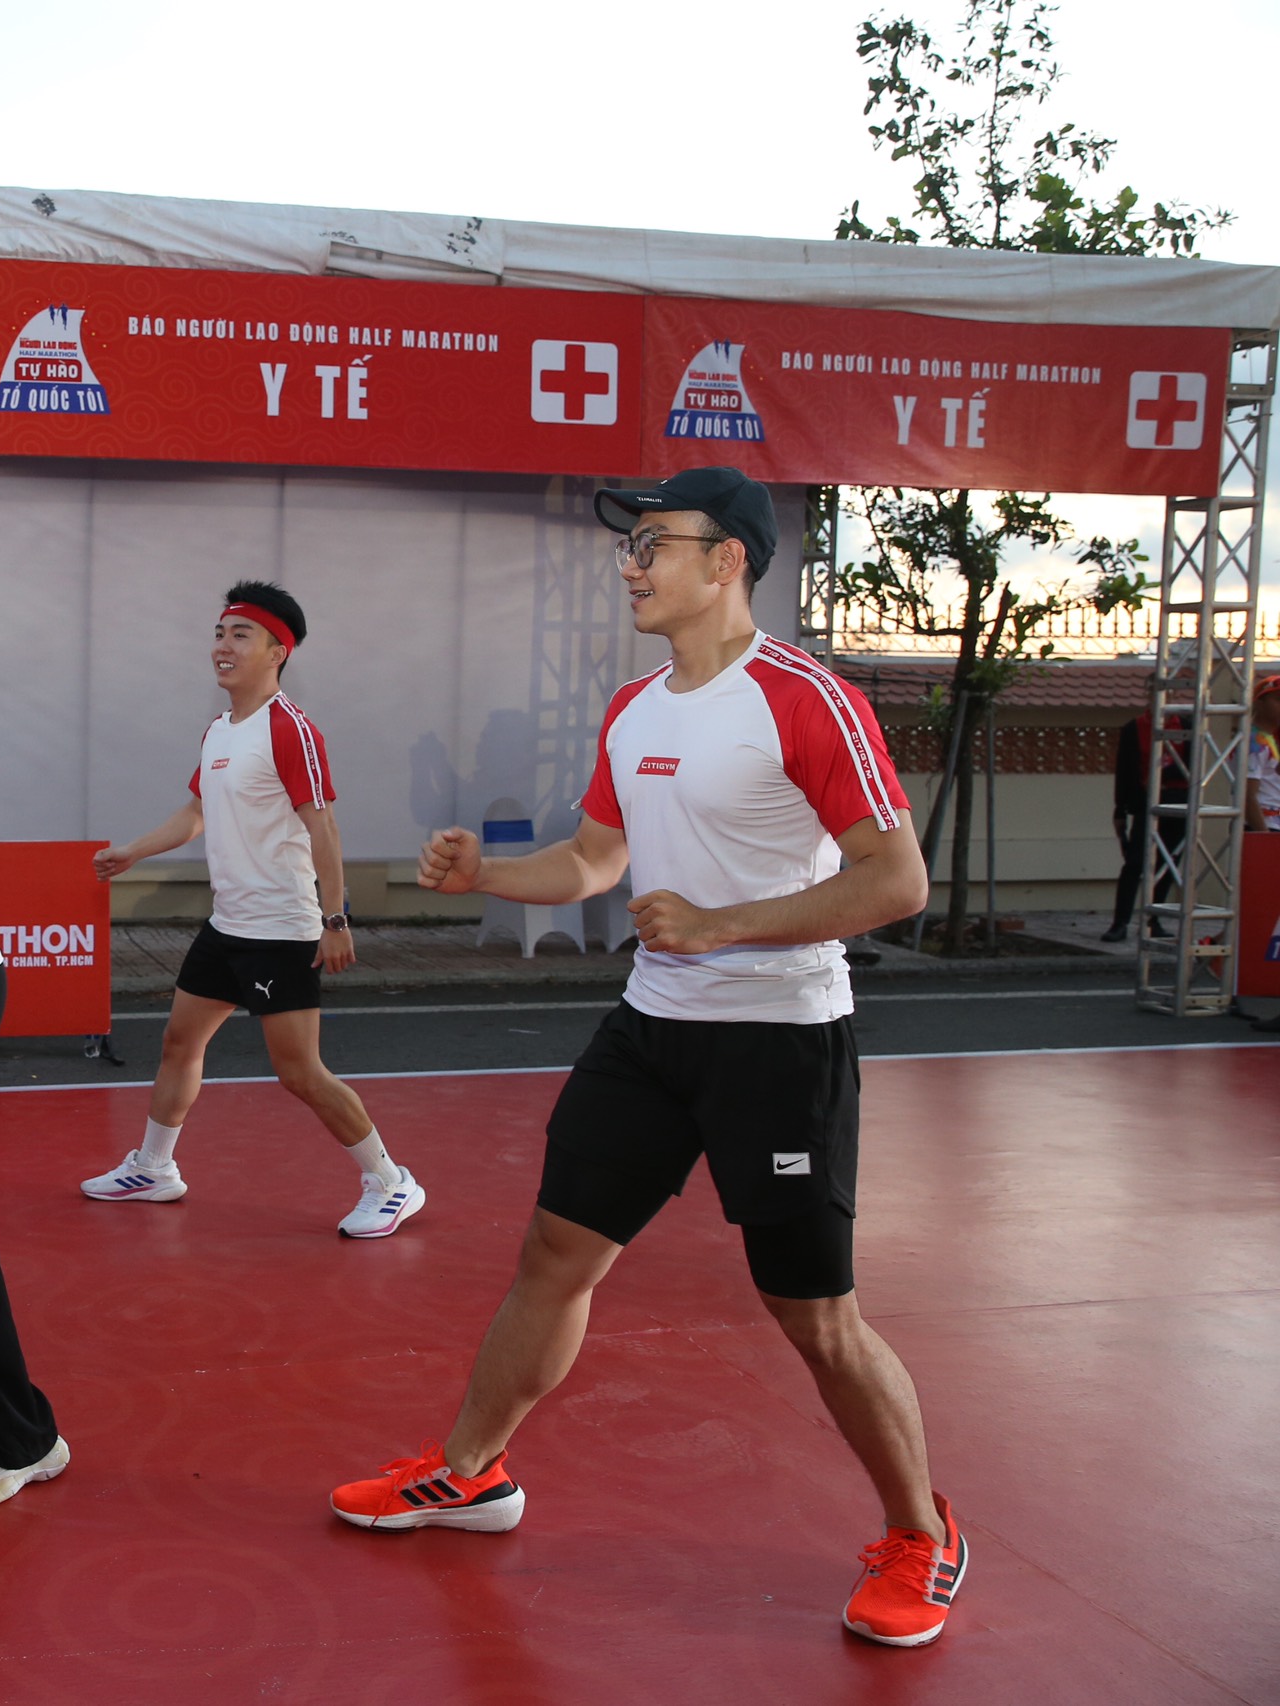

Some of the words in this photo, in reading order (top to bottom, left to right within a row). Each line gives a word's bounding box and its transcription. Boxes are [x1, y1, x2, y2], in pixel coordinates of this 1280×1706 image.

[128, 314, 165, 336] BÁO
[176, 318, 235, 339] NGƯỜI
[245, 321, 279, 341] LAO
[289, 321, 339, 346] ĐỘNG
[349, 326, 392, 347] HALF
[402, 329, 499, 352] MARATHON
[19, 362, 42, 380] TỰ
[46, 360, 78, 378] HÀO
[781, 350, 813, 370] BÁO
[822, 353, 872, 373] NGƯỜI
[881, 357, 911, 375] LAO
[971, 362, 1008, 380] HALF
[1016, 364, 1101, 384] MARATHON
[28, 384, 70, 412] QUỐC
[259, 362, 288, 416] Y
[315, 354, 373, 420] TẾ
[688, 393, 707, 408] TỰ
[711, 391, 739, 408] HÀO
[893, 395, 917, 445] Y
[941, 387, 991, 448] TẾ
[810, 671, 844, 708] CITIGYM
[641, 762, 676, 771] CITIGYM
[851, 731, 873, 780] CITIGYM
[55, 955, 94, 967] TP.HCM
